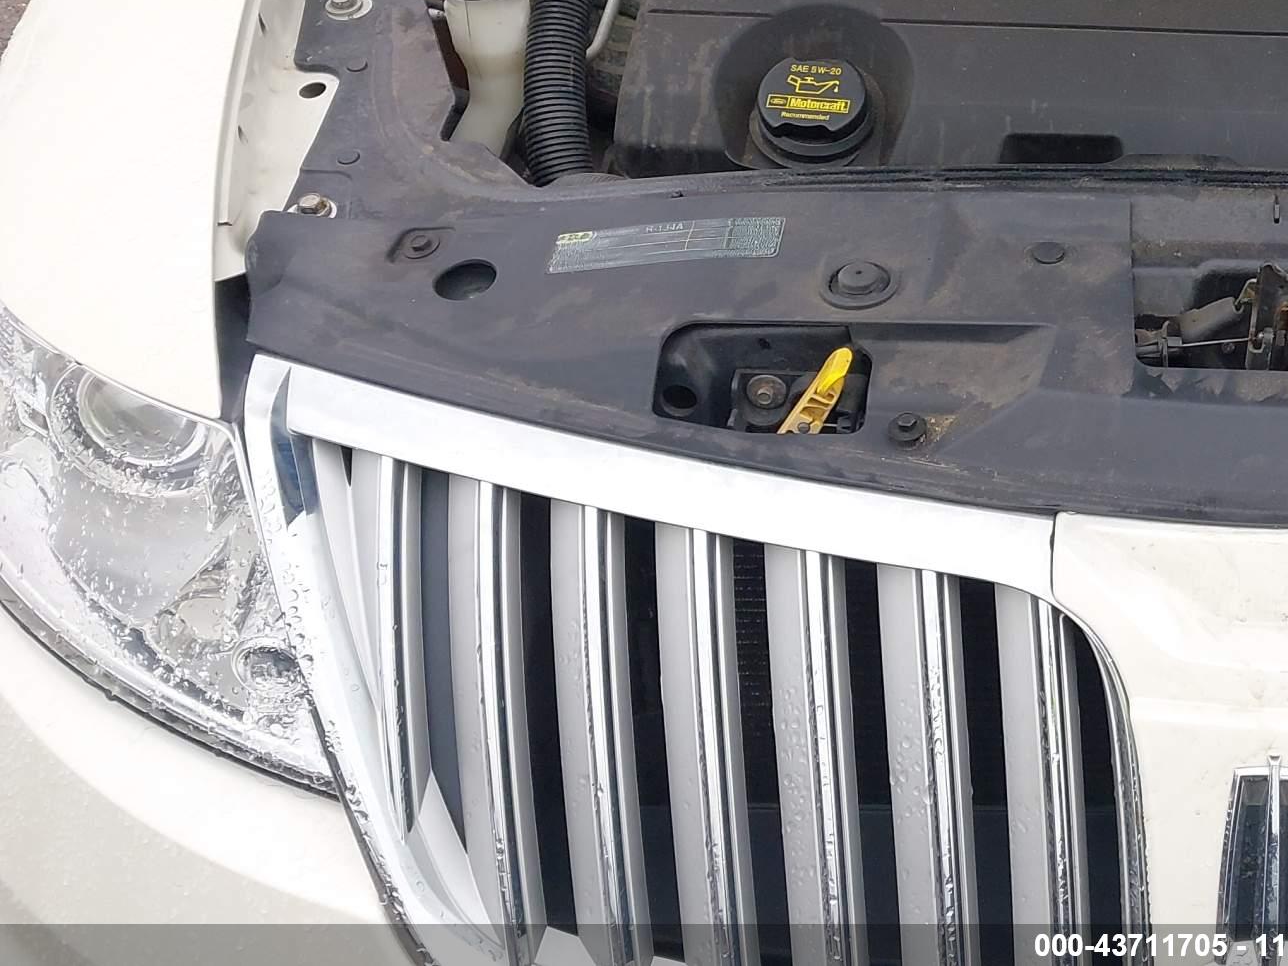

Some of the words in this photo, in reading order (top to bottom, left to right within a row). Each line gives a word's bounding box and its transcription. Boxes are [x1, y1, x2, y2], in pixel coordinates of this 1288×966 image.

[790, 64, 809, 73] SAE
[811, 66, 842, 76] 5W-20
[790, 98, 847, 111] Motorcraft
